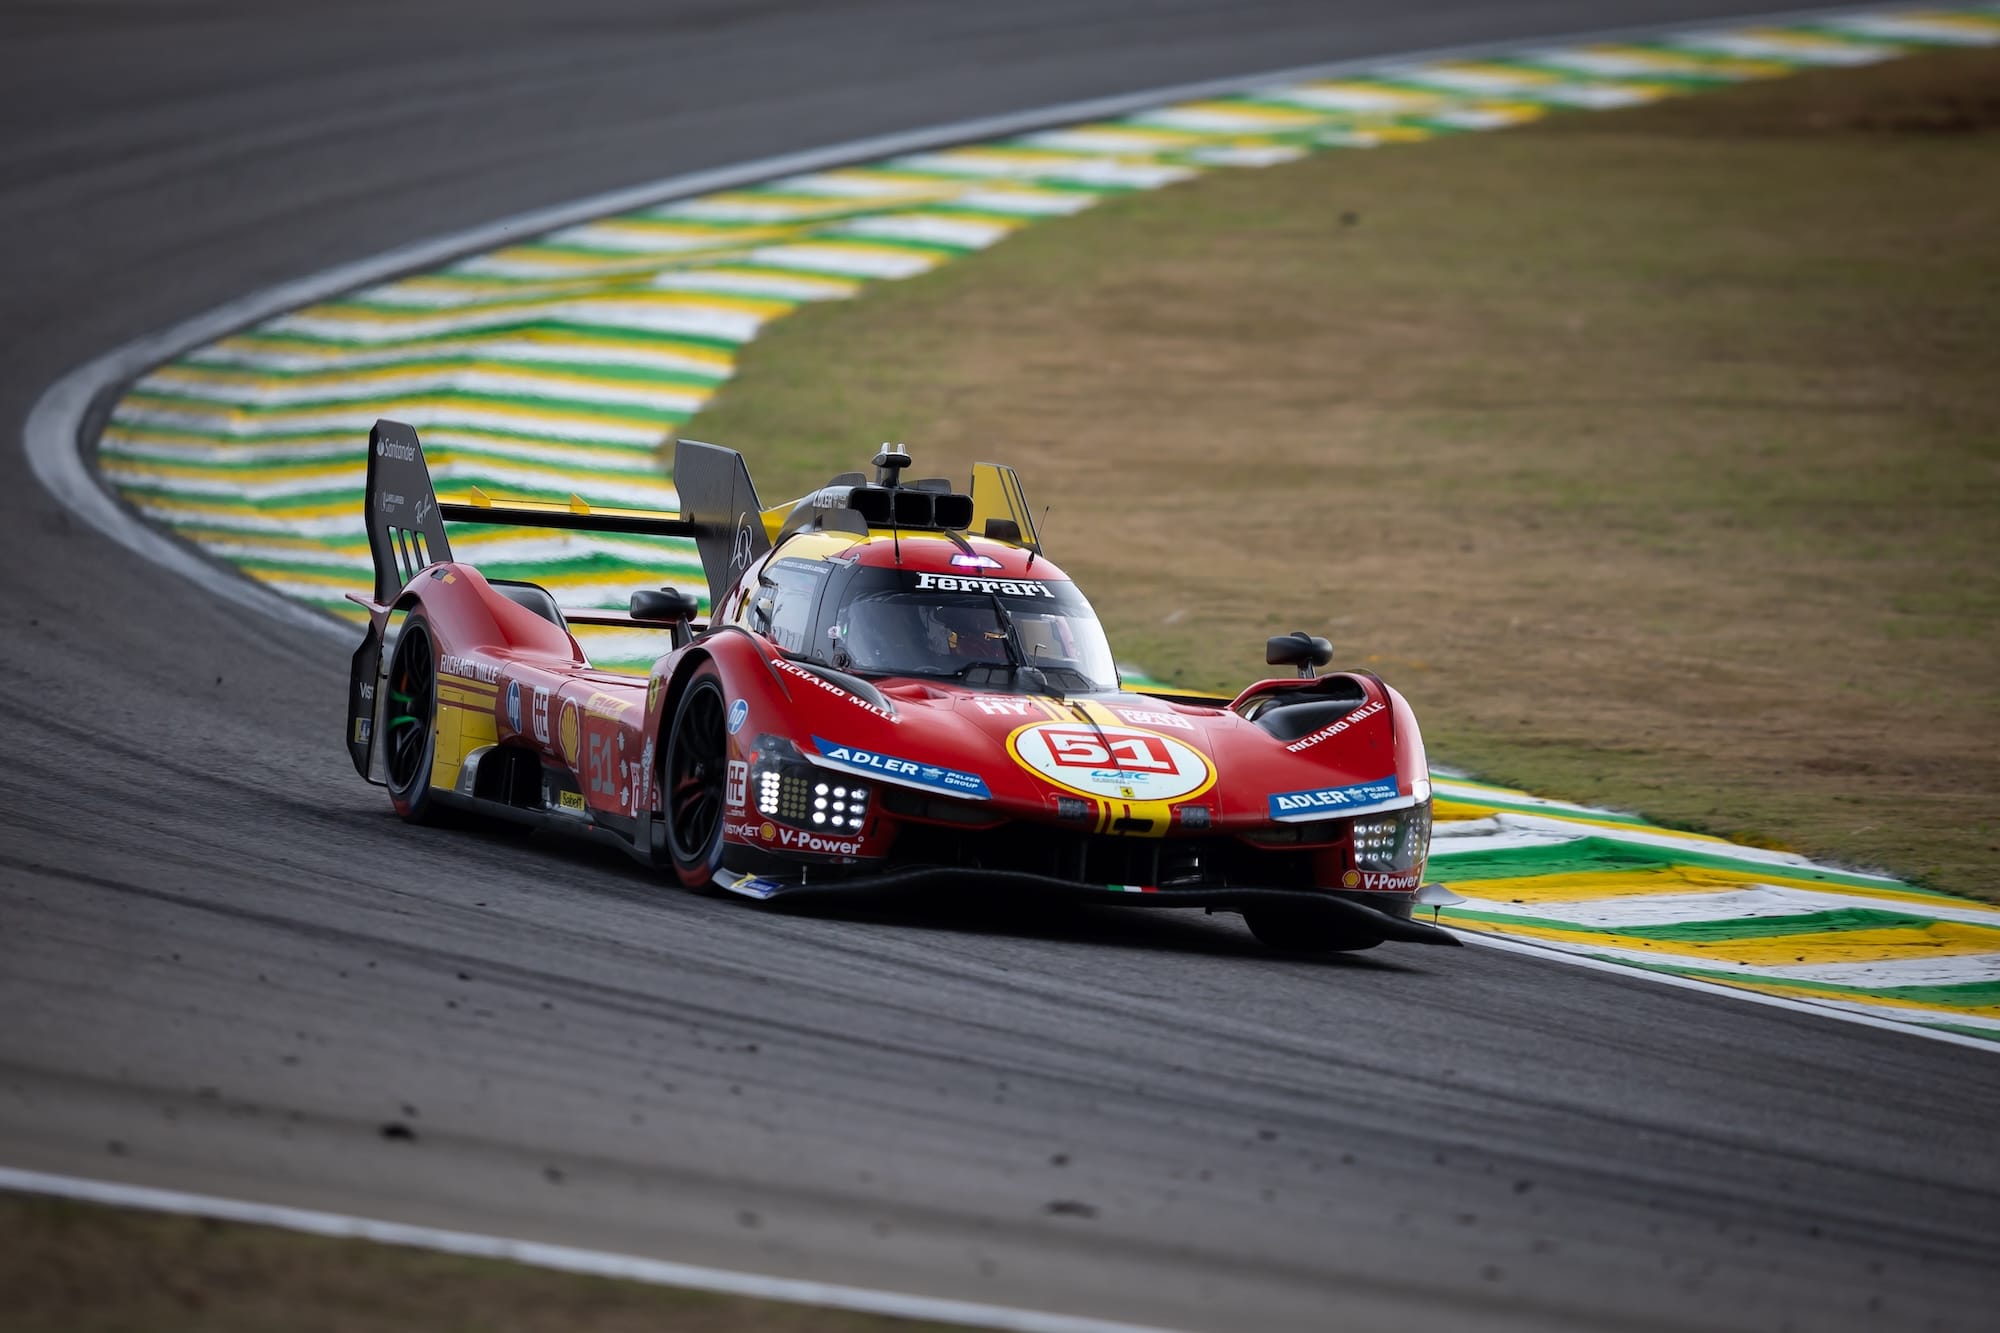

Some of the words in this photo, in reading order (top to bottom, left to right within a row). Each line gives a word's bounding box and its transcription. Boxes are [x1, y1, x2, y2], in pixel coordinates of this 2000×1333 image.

[384, 438, 415, 461] Santander
[915, 572, 1055, 599] Ferrari
[440, 654, 475, 678] RICHARD
[476, 662, 498, 684] MILLE
[771, 658, 845, 698] RICHARD
[849, 695, 903, 725] MILLE
[1286, 721, 1350, 753] RICHARD
[1346, 701, 1386, 725] MILLE
[589, 732, 616, 796] 51
[1049, 733, 1171, 770] 51
[827, 747, 918, 776] ADLER
[944, 777, 979, 789] GROUP
[1276, 790, 1350, 810] ADLER
[779, 828, 861, 855] V-Power
[1363, 873, 1418, 890] V-Power
